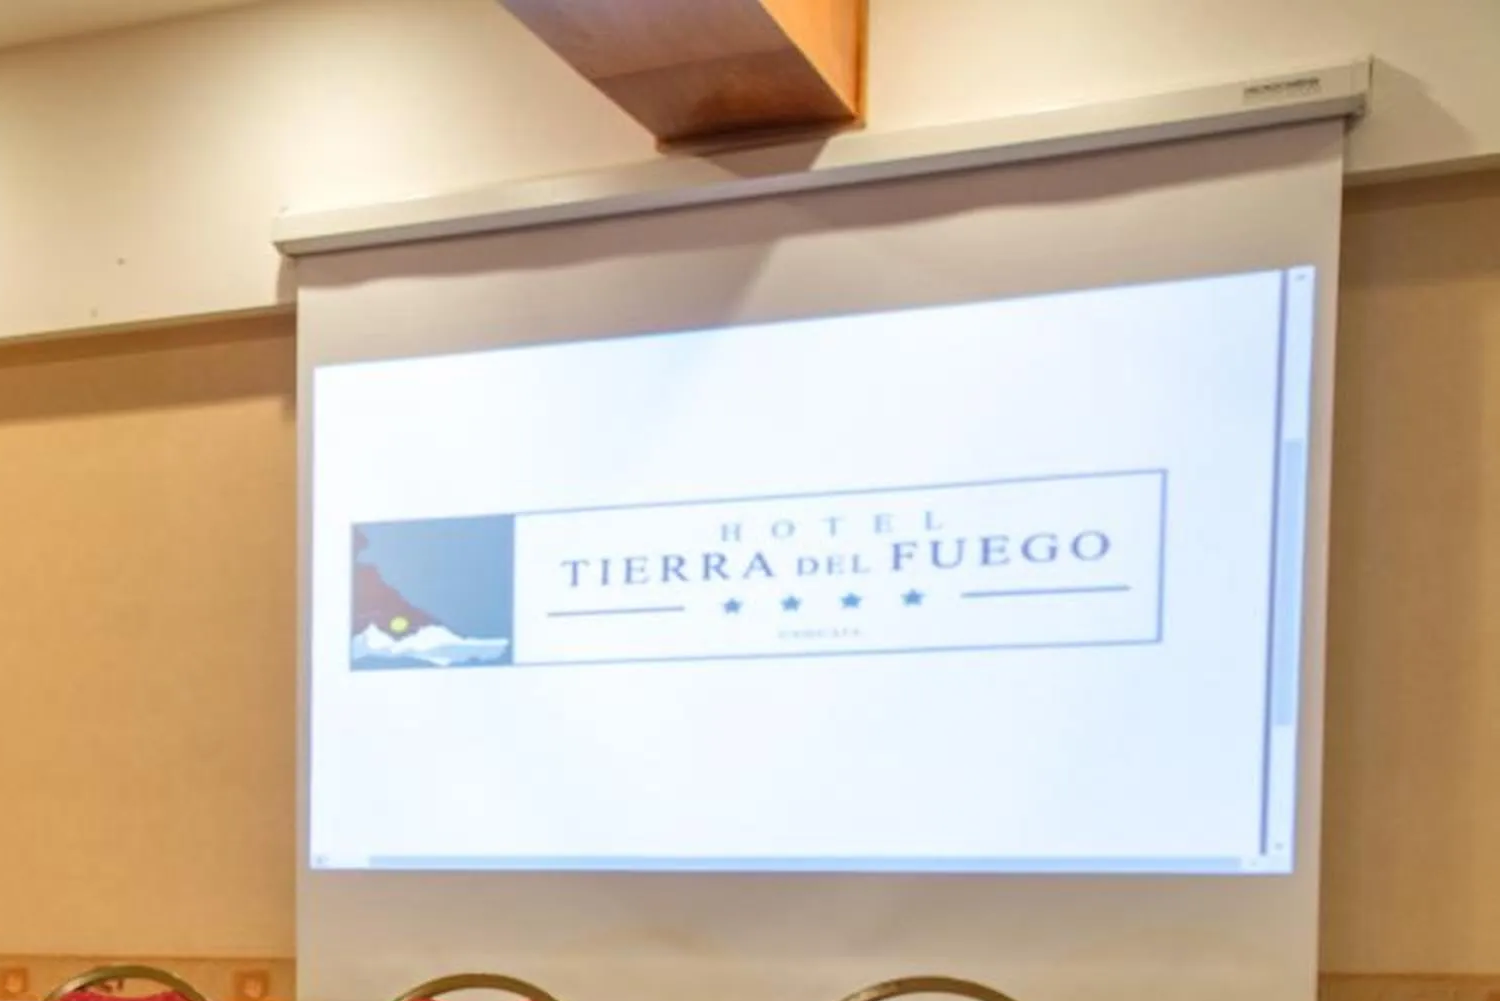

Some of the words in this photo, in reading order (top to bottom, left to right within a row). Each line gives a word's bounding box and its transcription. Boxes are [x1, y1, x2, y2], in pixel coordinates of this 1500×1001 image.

[720, 510, 943, 542] HOTEL
[560, 551, 776, 588] TIERRA
[796, 554, 870, 577] DEL
[892, 530, 1111, 572] FUEGO
